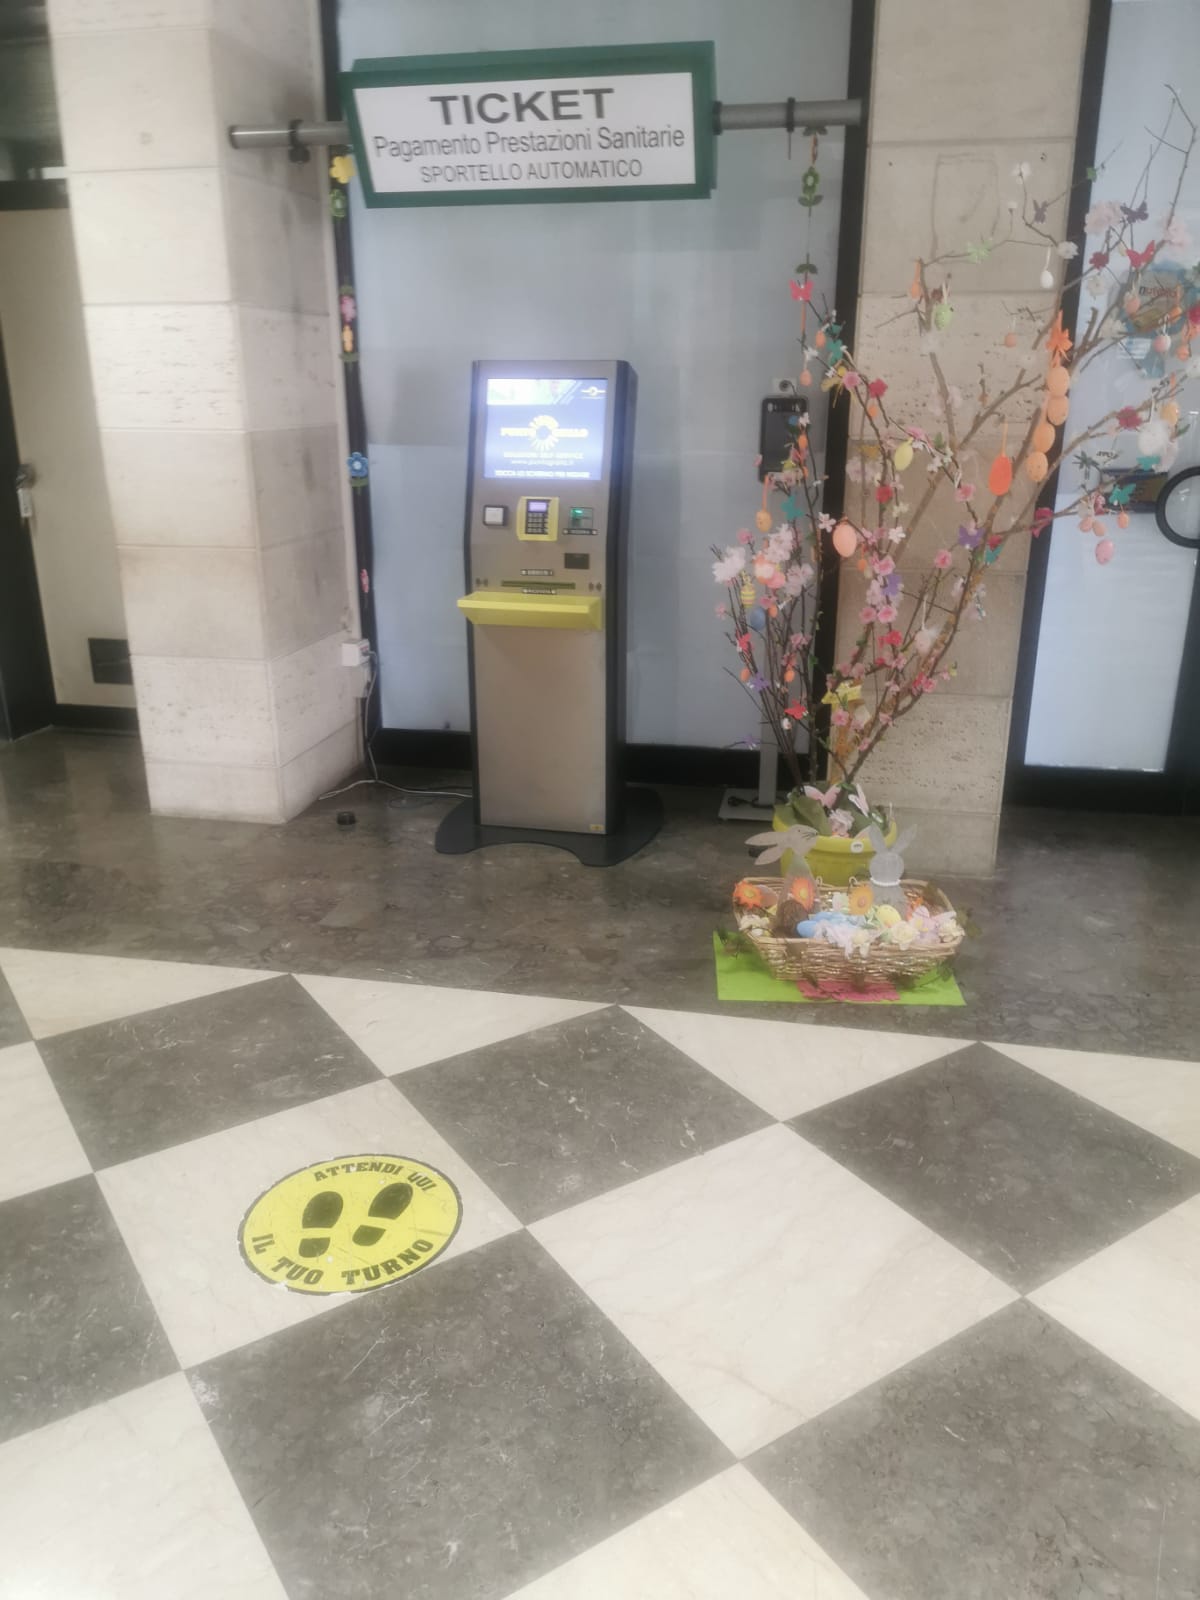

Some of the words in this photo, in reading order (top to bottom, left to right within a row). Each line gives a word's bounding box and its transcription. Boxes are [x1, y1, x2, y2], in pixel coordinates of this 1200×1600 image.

[429, 88, 614, 125] TICKET
[374, 136, 481, 164] Pagamento
[485, 127, 592, 153] Prestazioni
[597, 125, 685, 149] Sanitarie
[421, 163, 522, 183] SPORTELLO
[528, 159, 643, 181] AUTOMATICO
[314, 1161, 405, 1182] ATTENDI
[407, 1172, 437, 1191] QUI
[252, 1233, 275, 1254] IL
[271, 1256, 324, 1285] TUO
[341, 1239, 434, 1285] TURNO
